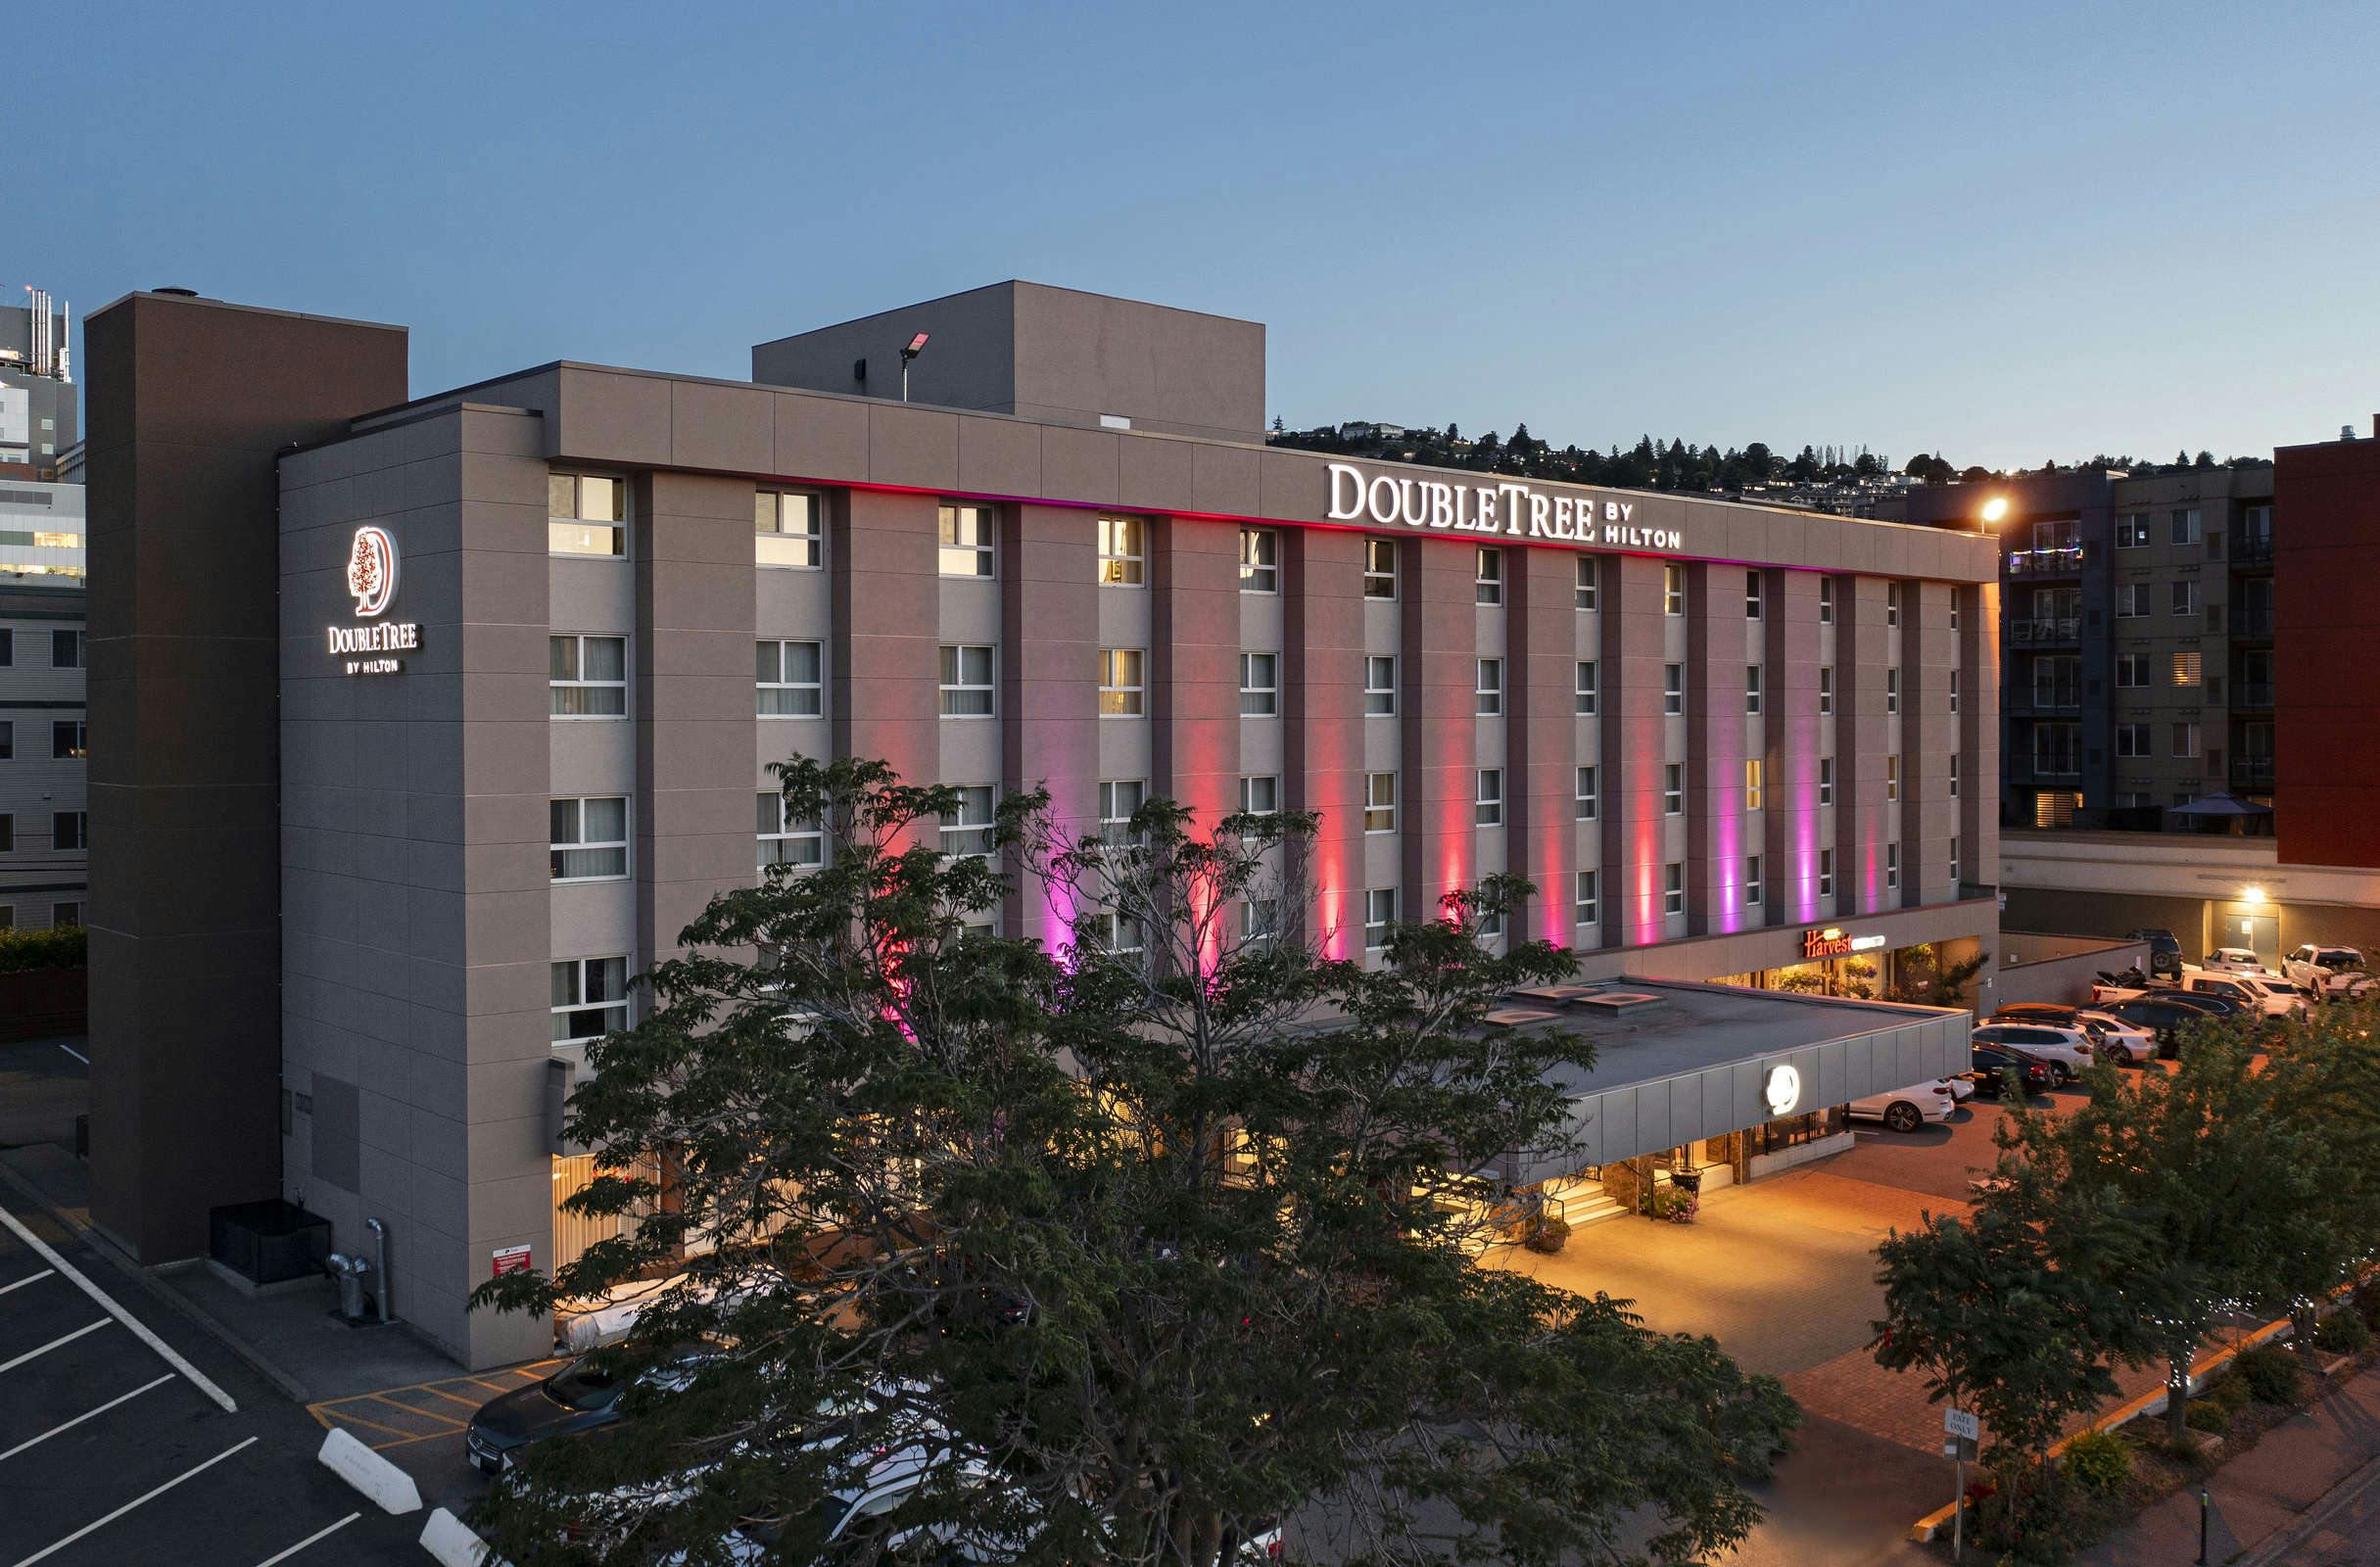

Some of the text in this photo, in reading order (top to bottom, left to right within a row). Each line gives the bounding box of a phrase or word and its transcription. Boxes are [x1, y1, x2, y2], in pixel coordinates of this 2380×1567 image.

[1605, 501, 1633, 520] BY
[1604, 525, 1680, 549] HILTON
[347, 659, 398, 674] BY HILTON
[1805, 929, 1852, 958] Harvest
[1950, 1422, 1973, 1435] ONLY
